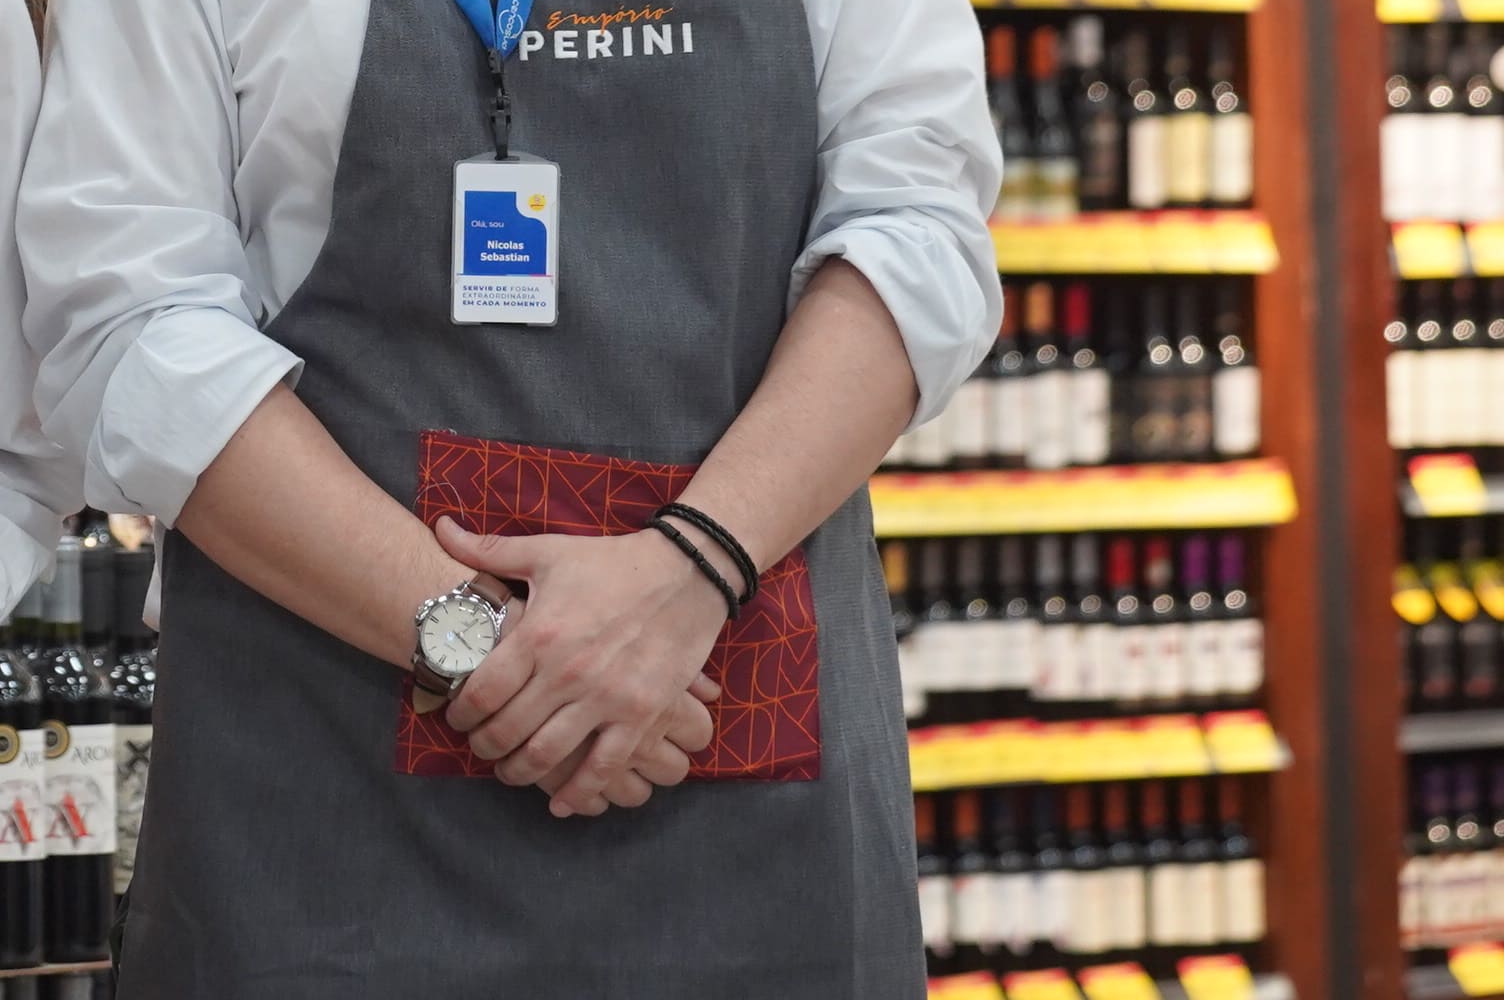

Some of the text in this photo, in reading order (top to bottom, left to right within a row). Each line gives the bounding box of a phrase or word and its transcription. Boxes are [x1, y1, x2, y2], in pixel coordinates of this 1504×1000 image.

[518, 22, 694, 62] PERINI
[487, 240, 525, 250] Nicolas
[480, 252, 530, 262] Sebastian
